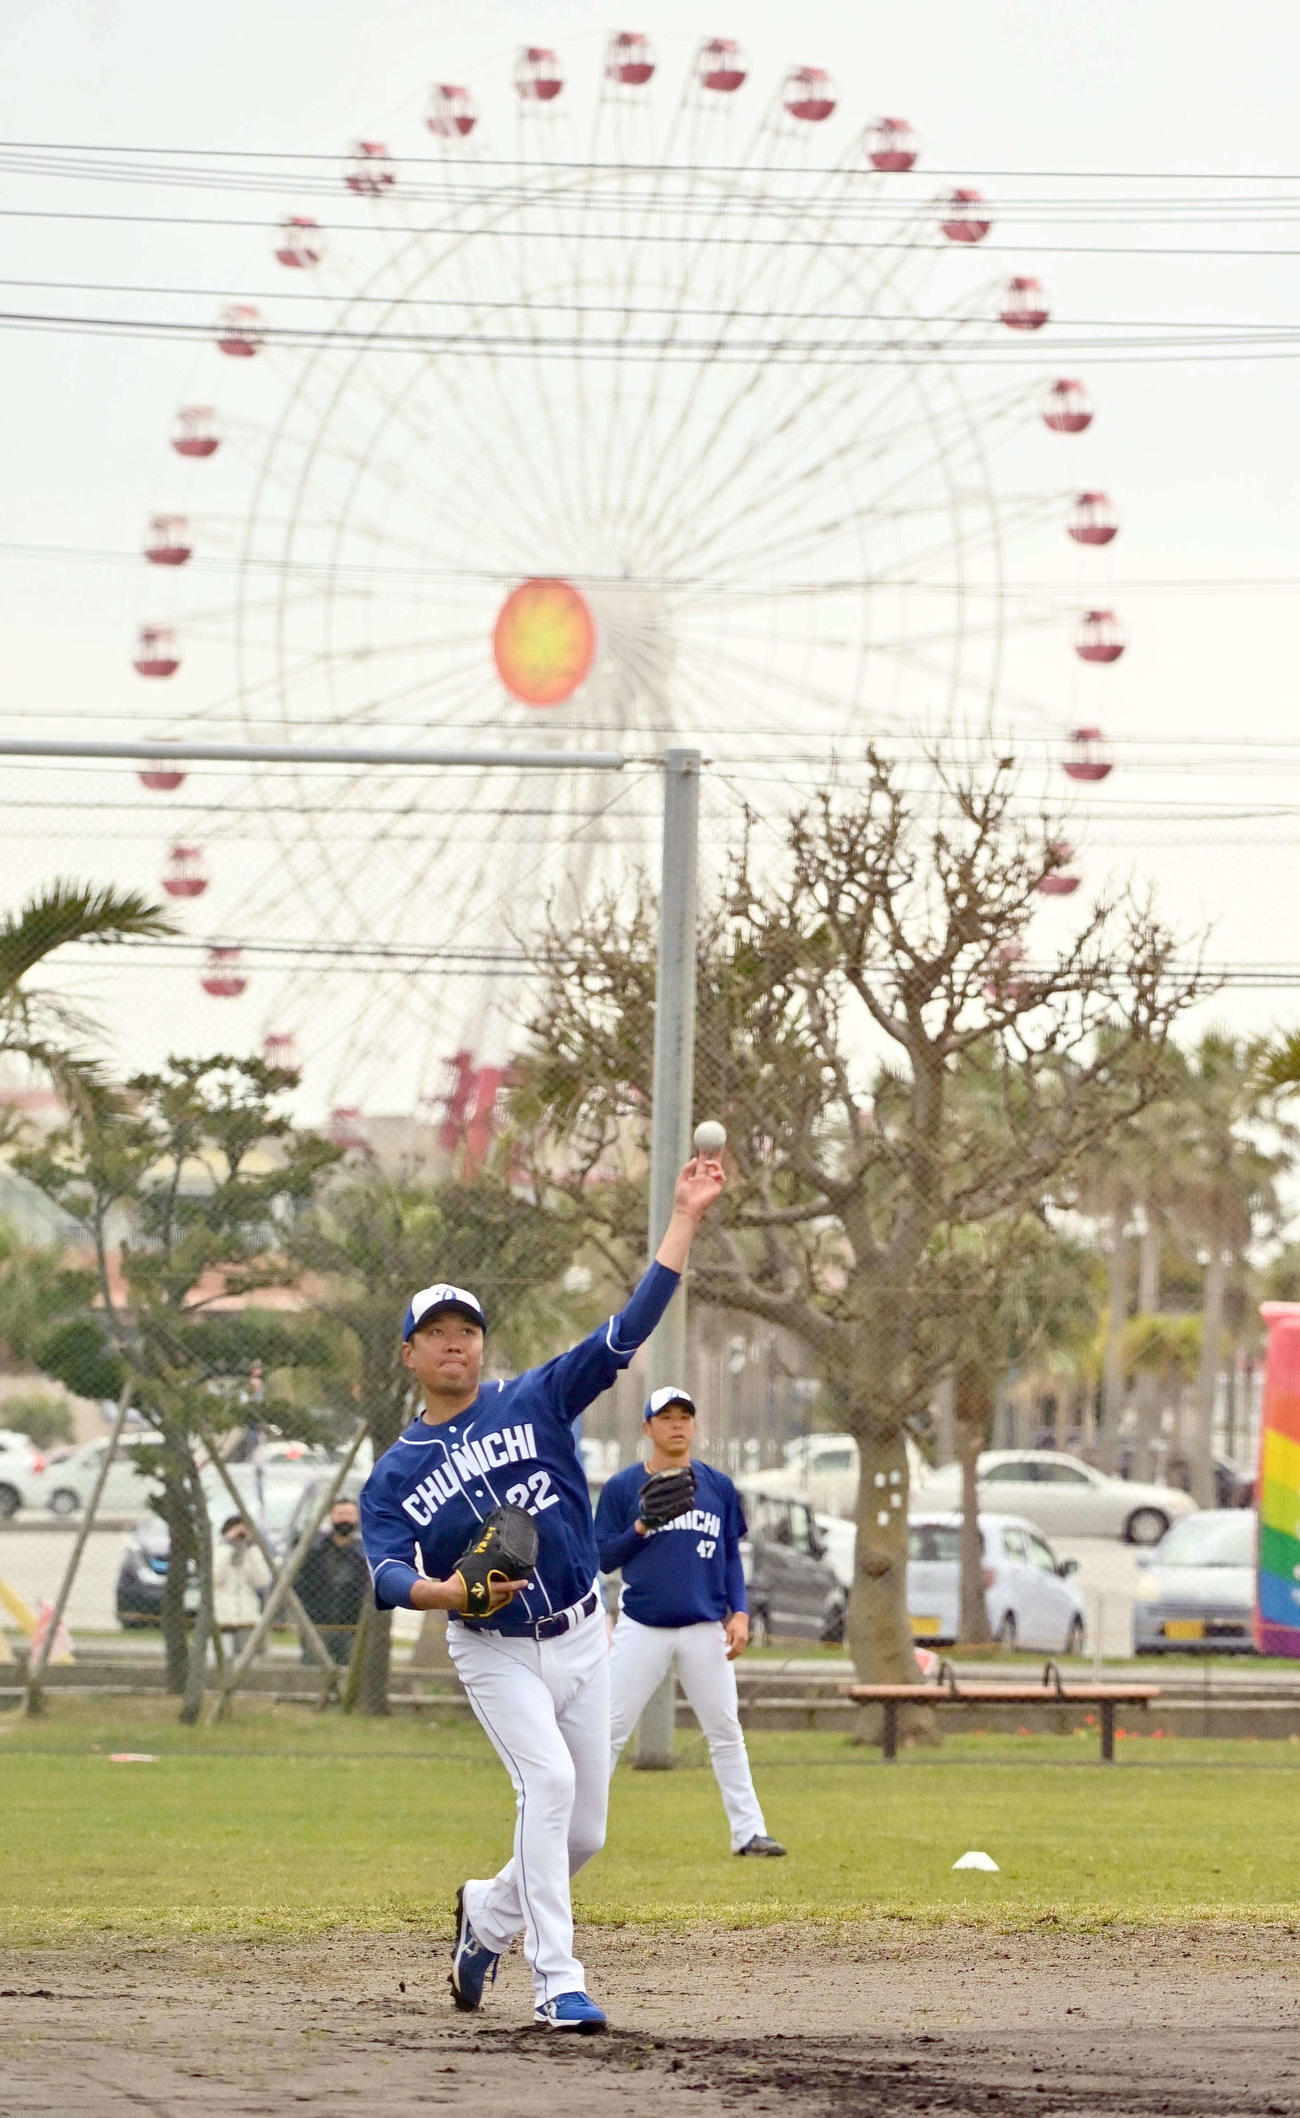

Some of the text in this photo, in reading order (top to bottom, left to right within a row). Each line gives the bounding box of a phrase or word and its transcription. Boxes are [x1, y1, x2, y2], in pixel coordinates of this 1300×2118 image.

[401, 1423, 538, 1527] CHUNICHI
[505, 1470, 560, 1516] 22
[696, 1539, 717, 1559] 47
